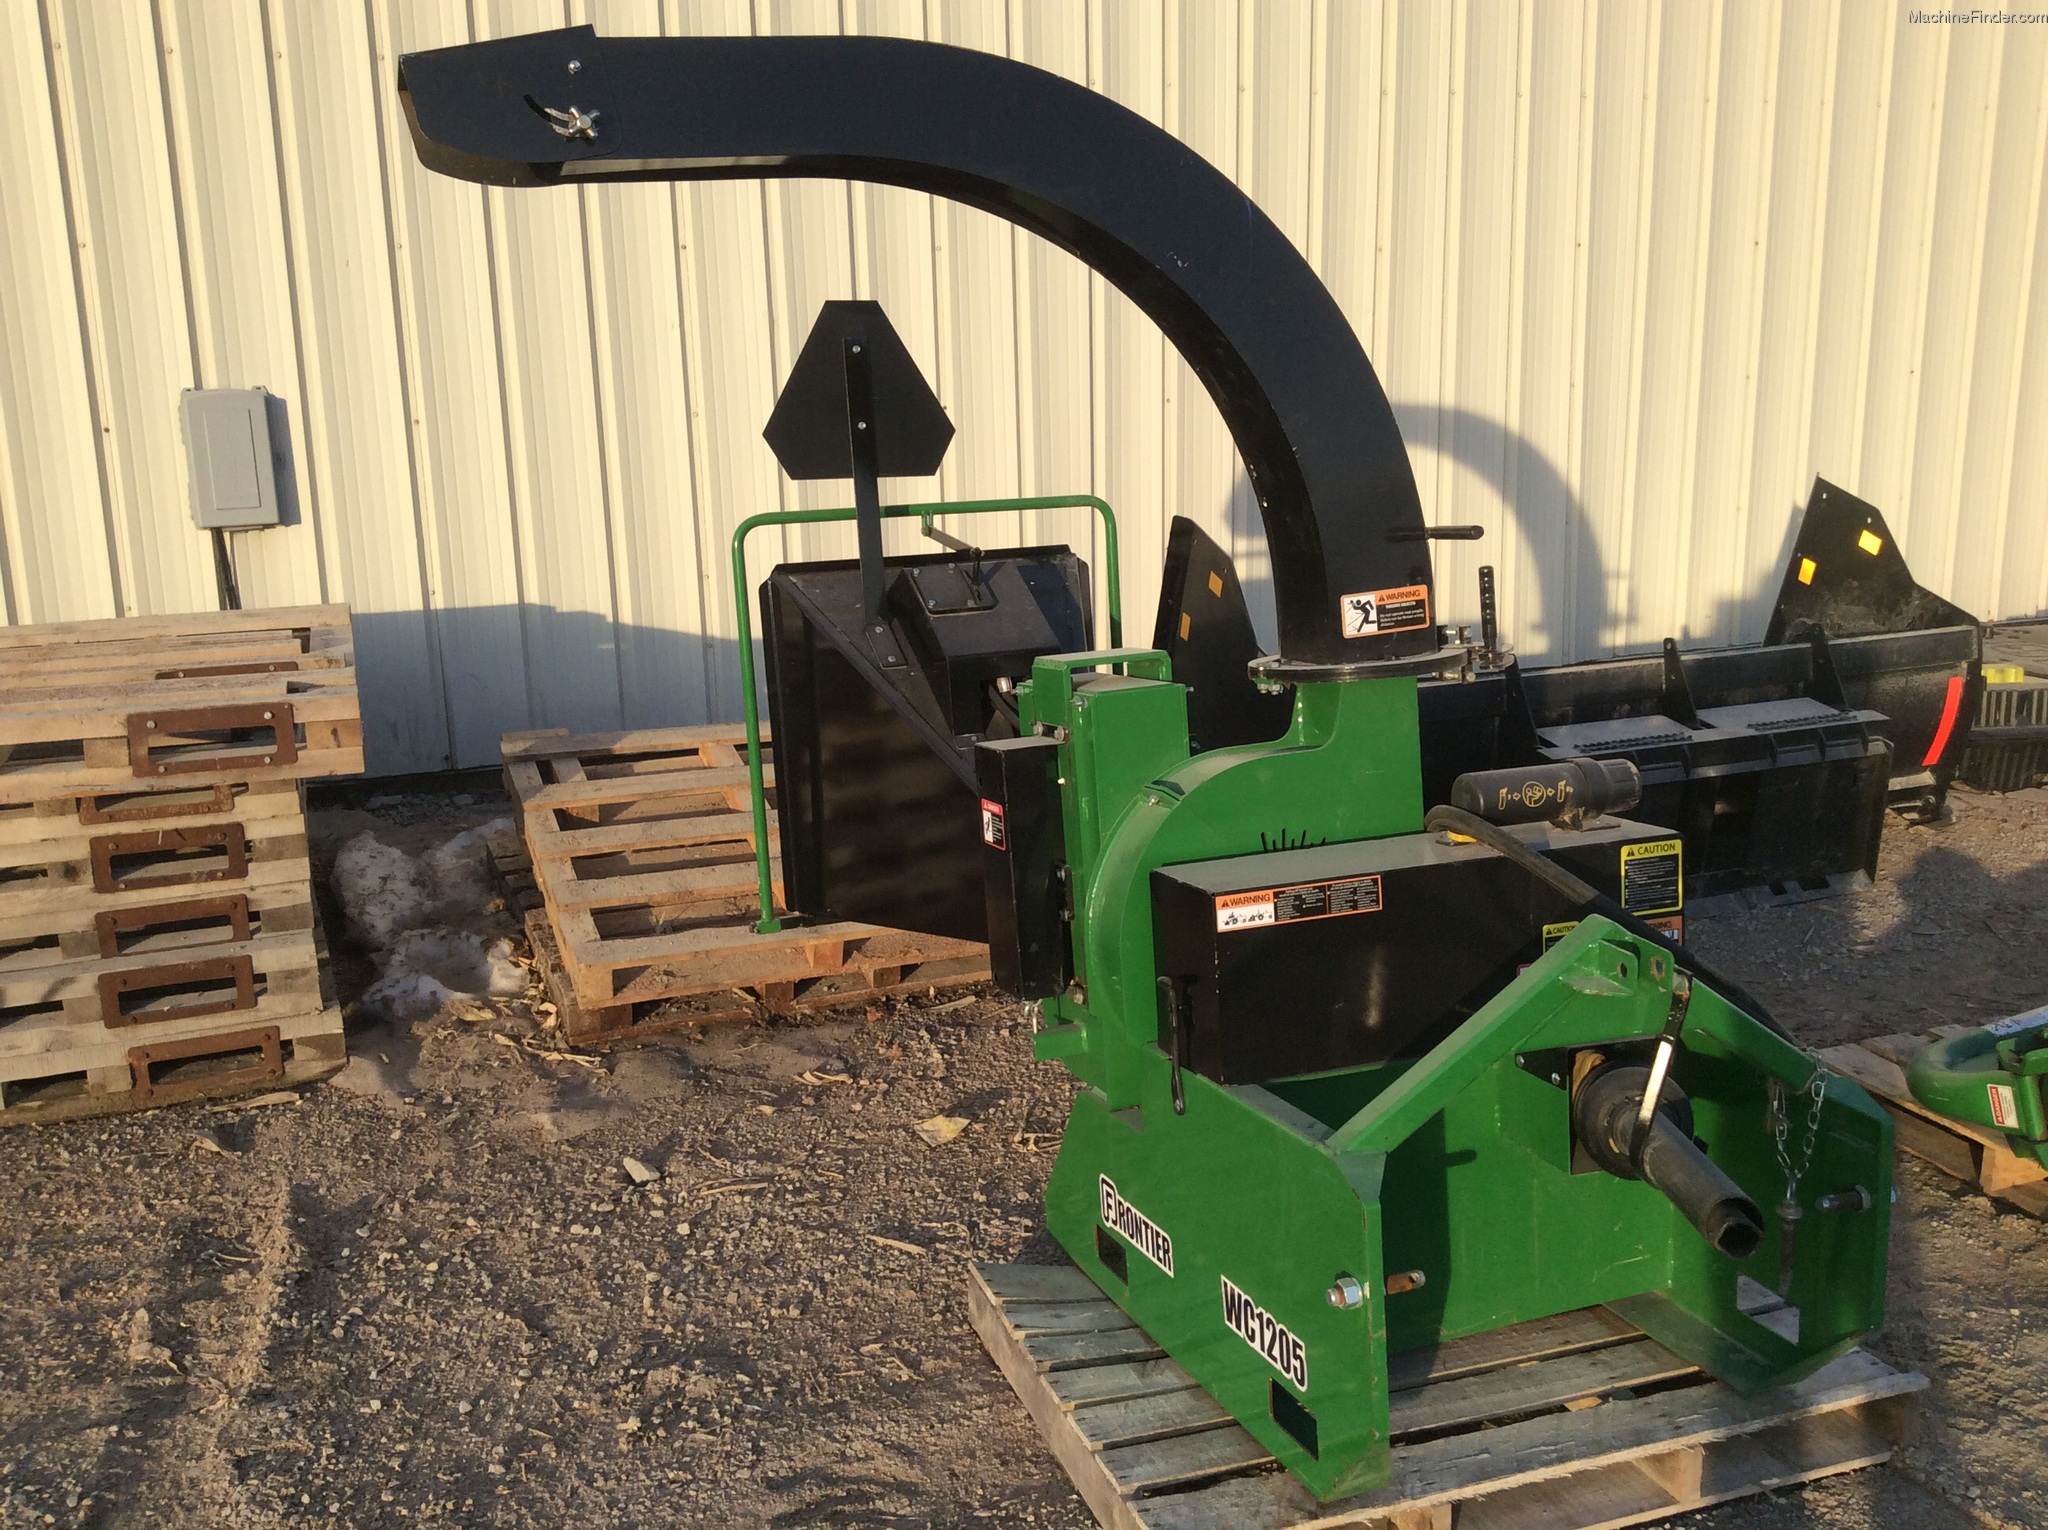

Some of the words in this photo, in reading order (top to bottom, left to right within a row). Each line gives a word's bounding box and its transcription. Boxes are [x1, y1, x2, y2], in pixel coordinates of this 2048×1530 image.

[1385, 590, 1420, 600] WARNING
[1637, 843, 1676, 856] CAUTION
[1229, 893, 1271, 907] WARNING
[1100, 1175, 1174, 1274] FRONTIER
[1221, 1277, 1307, 1390] WC1205
